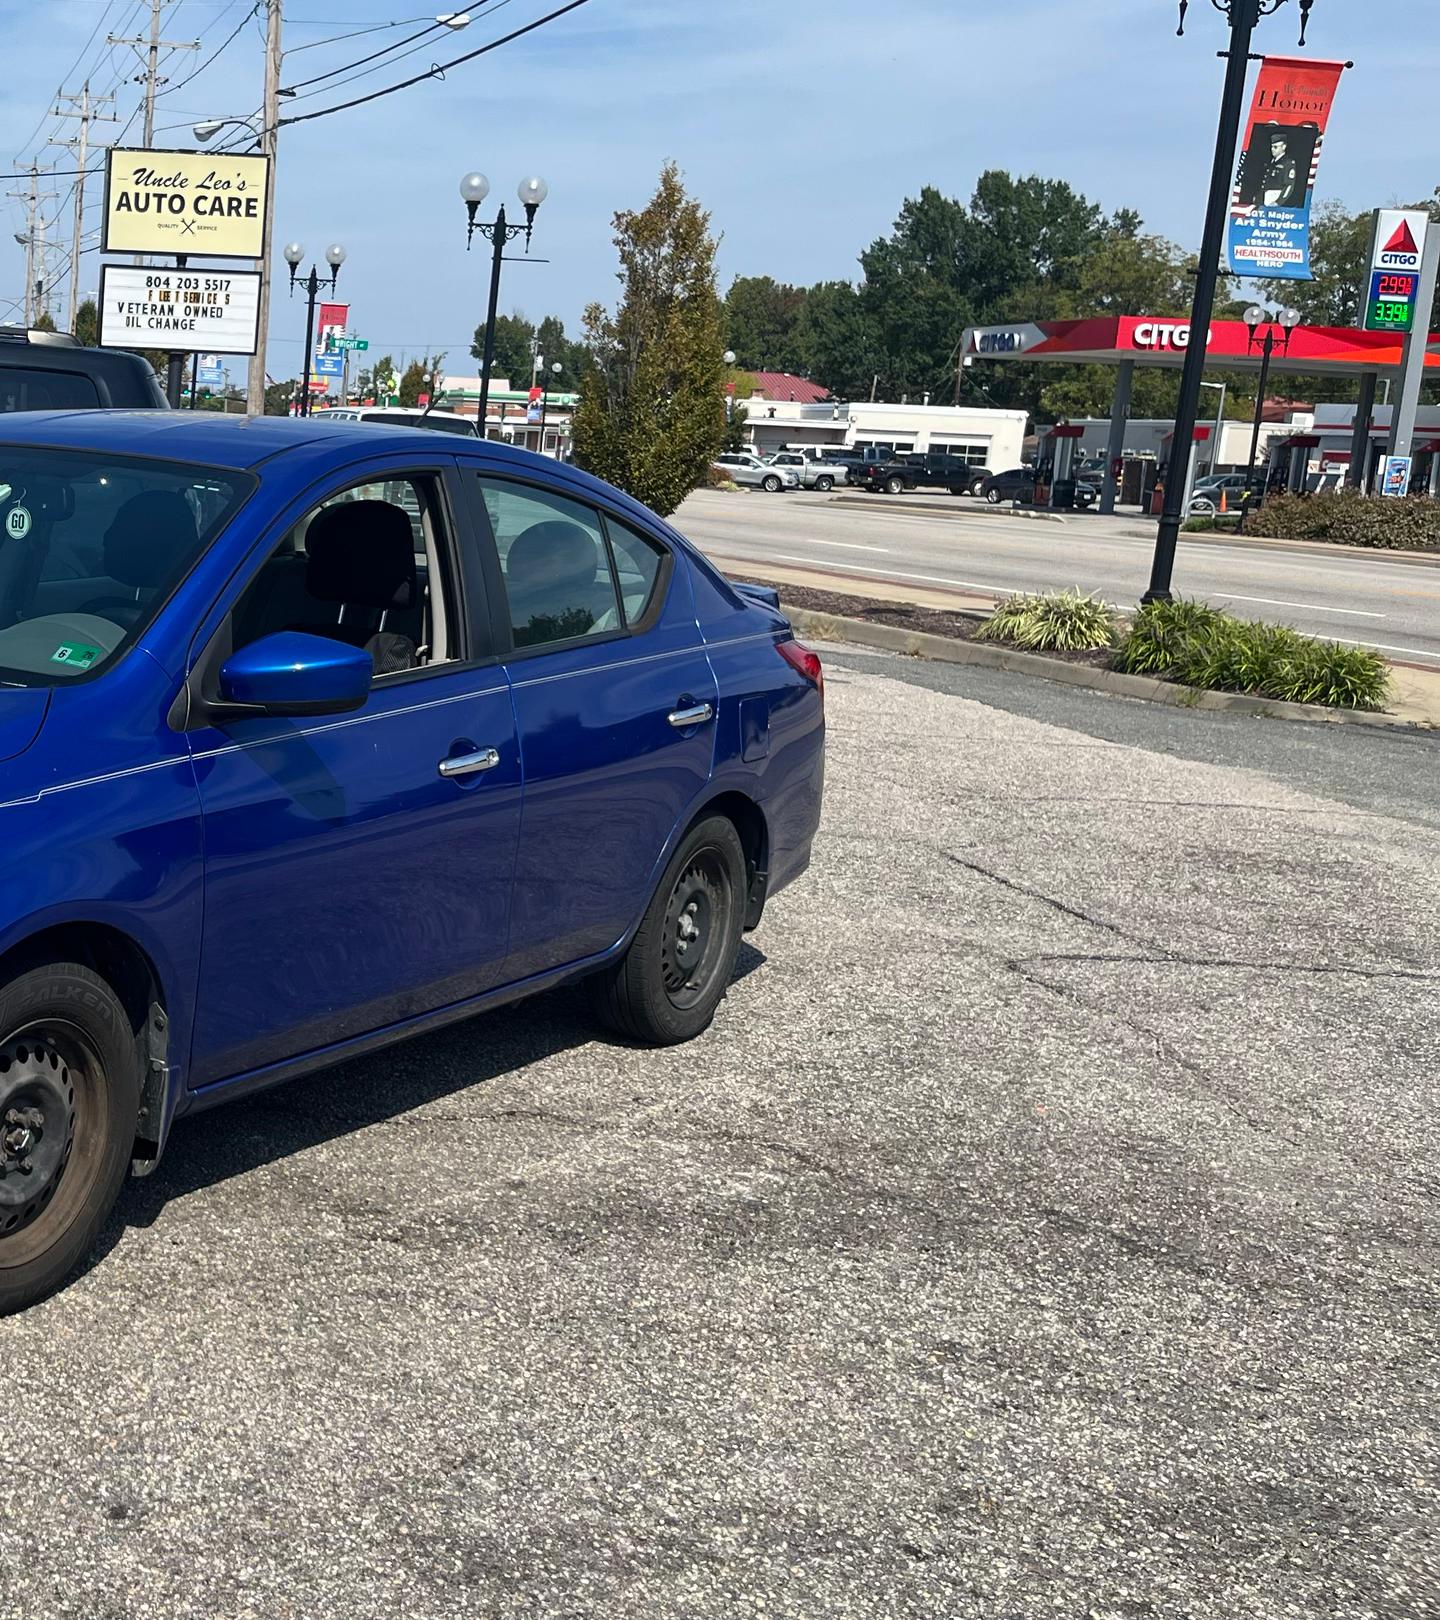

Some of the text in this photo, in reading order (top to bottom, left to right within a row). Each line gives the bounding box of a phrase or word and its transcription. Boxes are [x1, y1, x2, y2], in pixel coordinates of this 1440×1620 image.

[1257, 90, 1328, 112] Honor
[132, 167, 248, 192] Uncle Leo's
[115, 191, 259, 218] AUTO CARE
[1268, 211, 1295, 221] Major
[1235, 218, 1304, 230] Art Snyder
[1252, 229, 1287, 240] Army
[1235, 249, 1301, 260] HEALTHSOUTH
[1381, 253, 1417, 265] CITGO
[145, 276, 231, 292] 804 203 5517
[117, 302, 223, 319] VETERAN OWNED
[125, 316, 196, 331] OIL CHANGE
[1134, 322, 1212, 348] CITG
[334, 340, 358, 349] WRIGHT
[11, 513, 25, 530] GO
